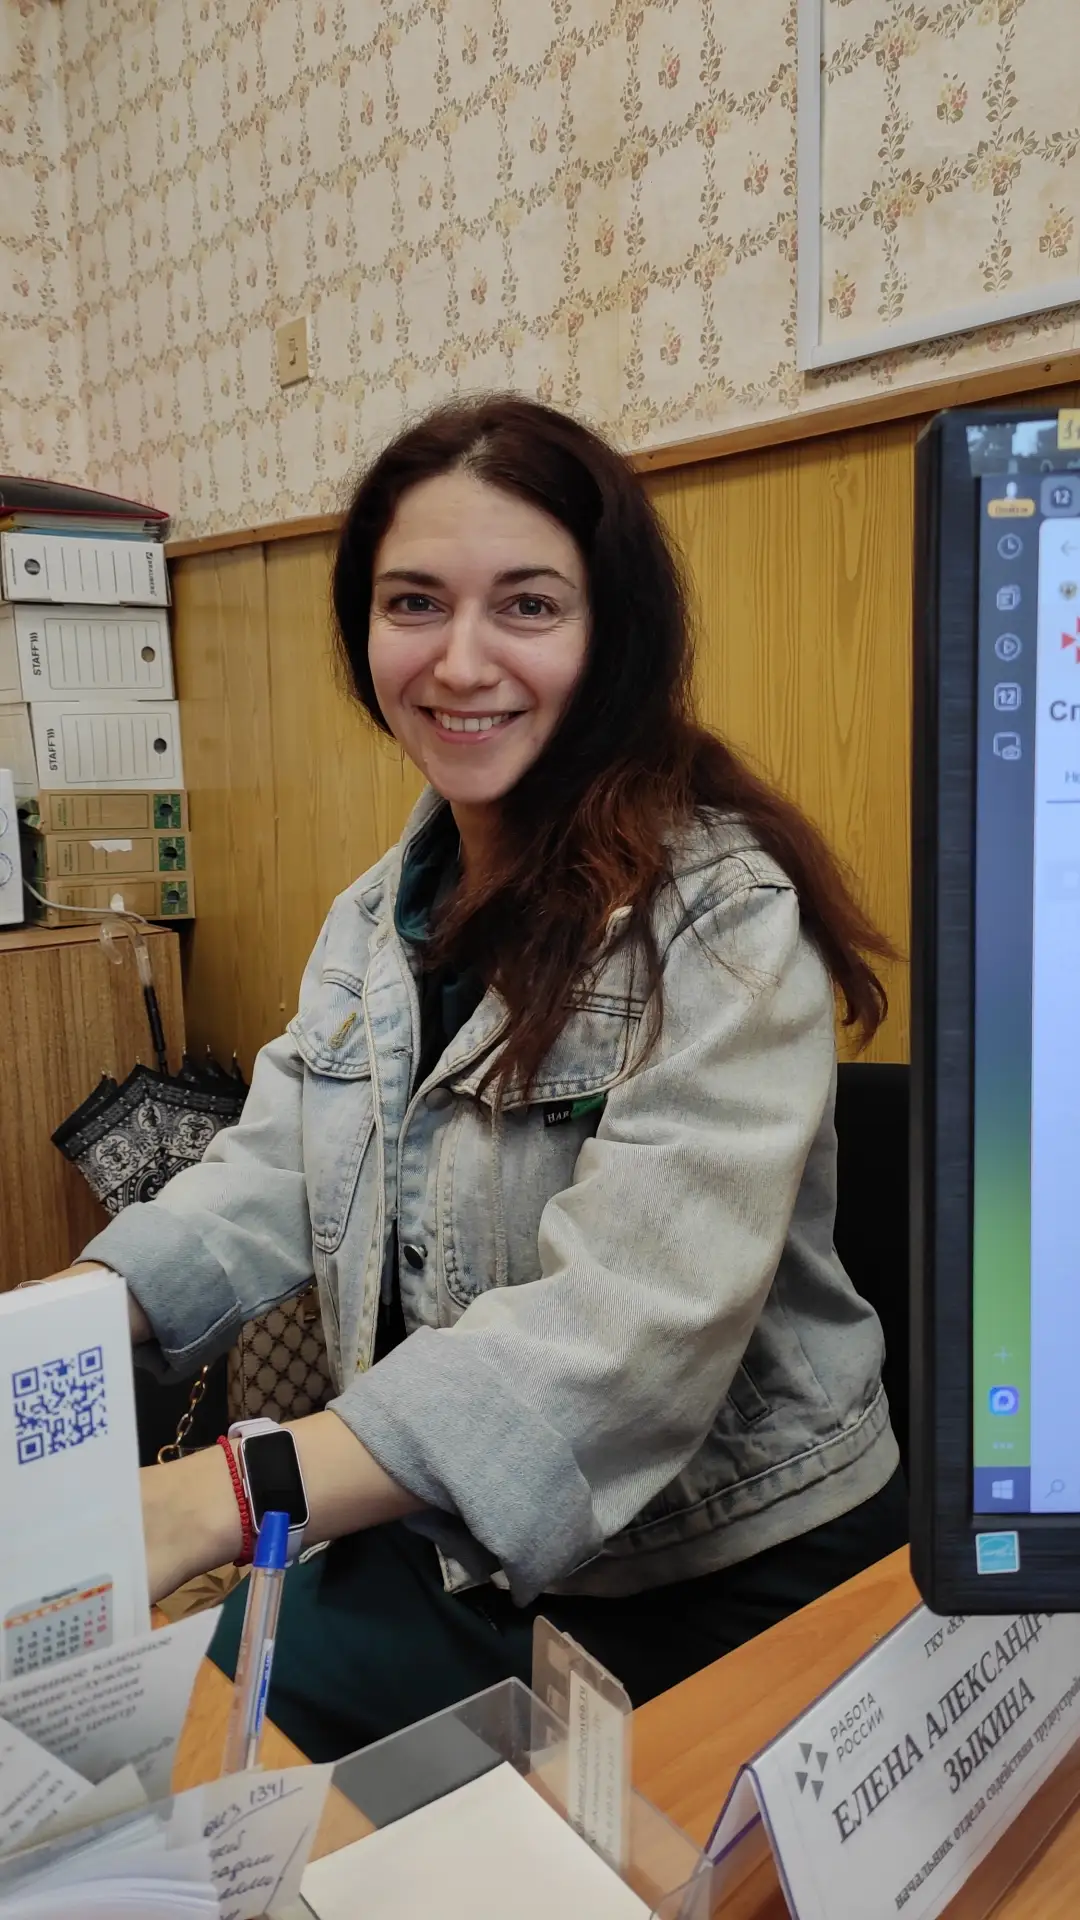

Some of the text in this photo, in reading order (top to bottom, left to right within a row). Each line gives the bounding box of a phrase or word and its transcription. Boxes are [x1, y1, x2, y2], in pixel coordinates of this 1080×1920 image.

[31, 641, 42, 676] STAFF
[48, 737, 58, 771] STAFF
[923, 1628, 944, 1659] ГКУ
[830, 1692, 876, 1743] РАБОТА
[836, 1707, 885, 1763] РОССИИ
[943, 1677, 1036, 1796] ЗЫКИНА
[832, 1733, 924, 1844] ЕЛЕНА
[895, 1834, 954, 1911] начальник
[953, 1796, 987, 1841] отдела
[985, 1738, 1034, 1802] содействия
